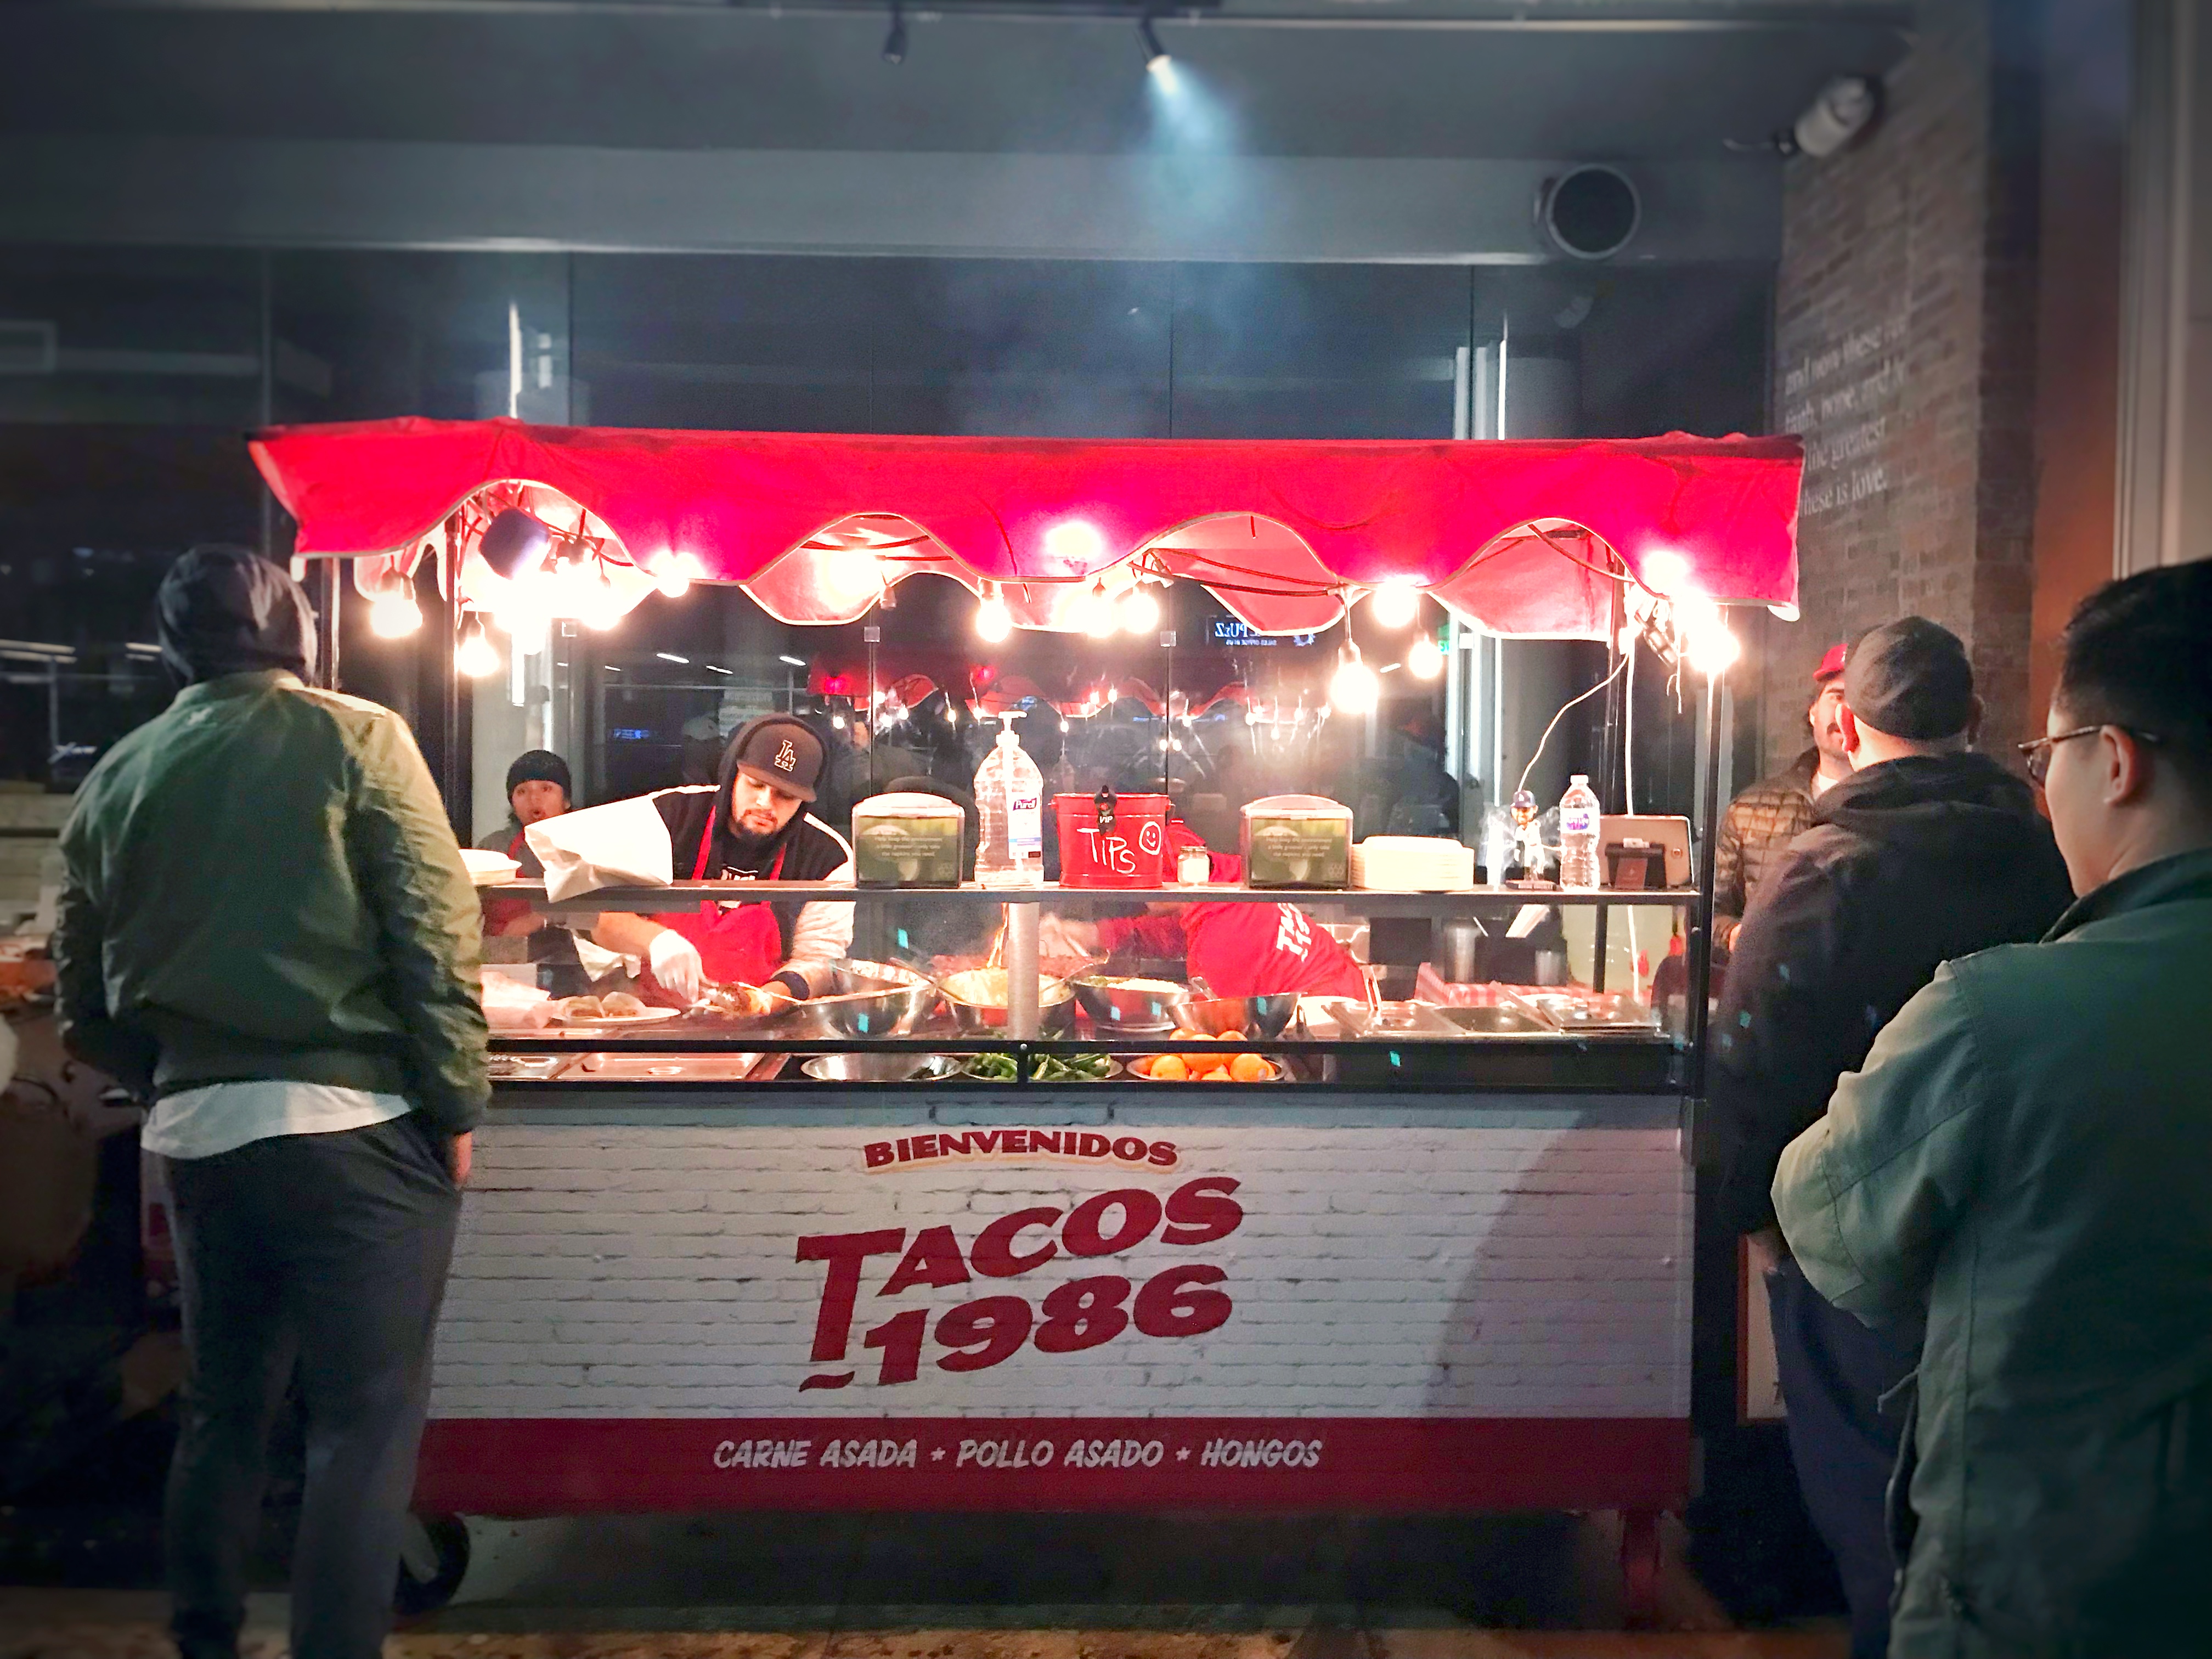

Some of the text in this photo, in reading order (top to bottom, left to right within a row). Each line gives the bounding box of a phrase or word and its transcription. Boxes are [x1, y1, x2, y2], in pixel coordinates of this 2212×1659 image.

[1837, 476, 1848, 504] is
[774, 740, 796, 771] LA
[864, 1130, 1178, 1169] BIENVENIDOS
[795, 1177, 1243, 1362] TACOS
[864, 1264, 1233, 1385] 1986
[714, 1438, 1323, 1468] CARNE ASADA POLLO ASADO HONGOS
